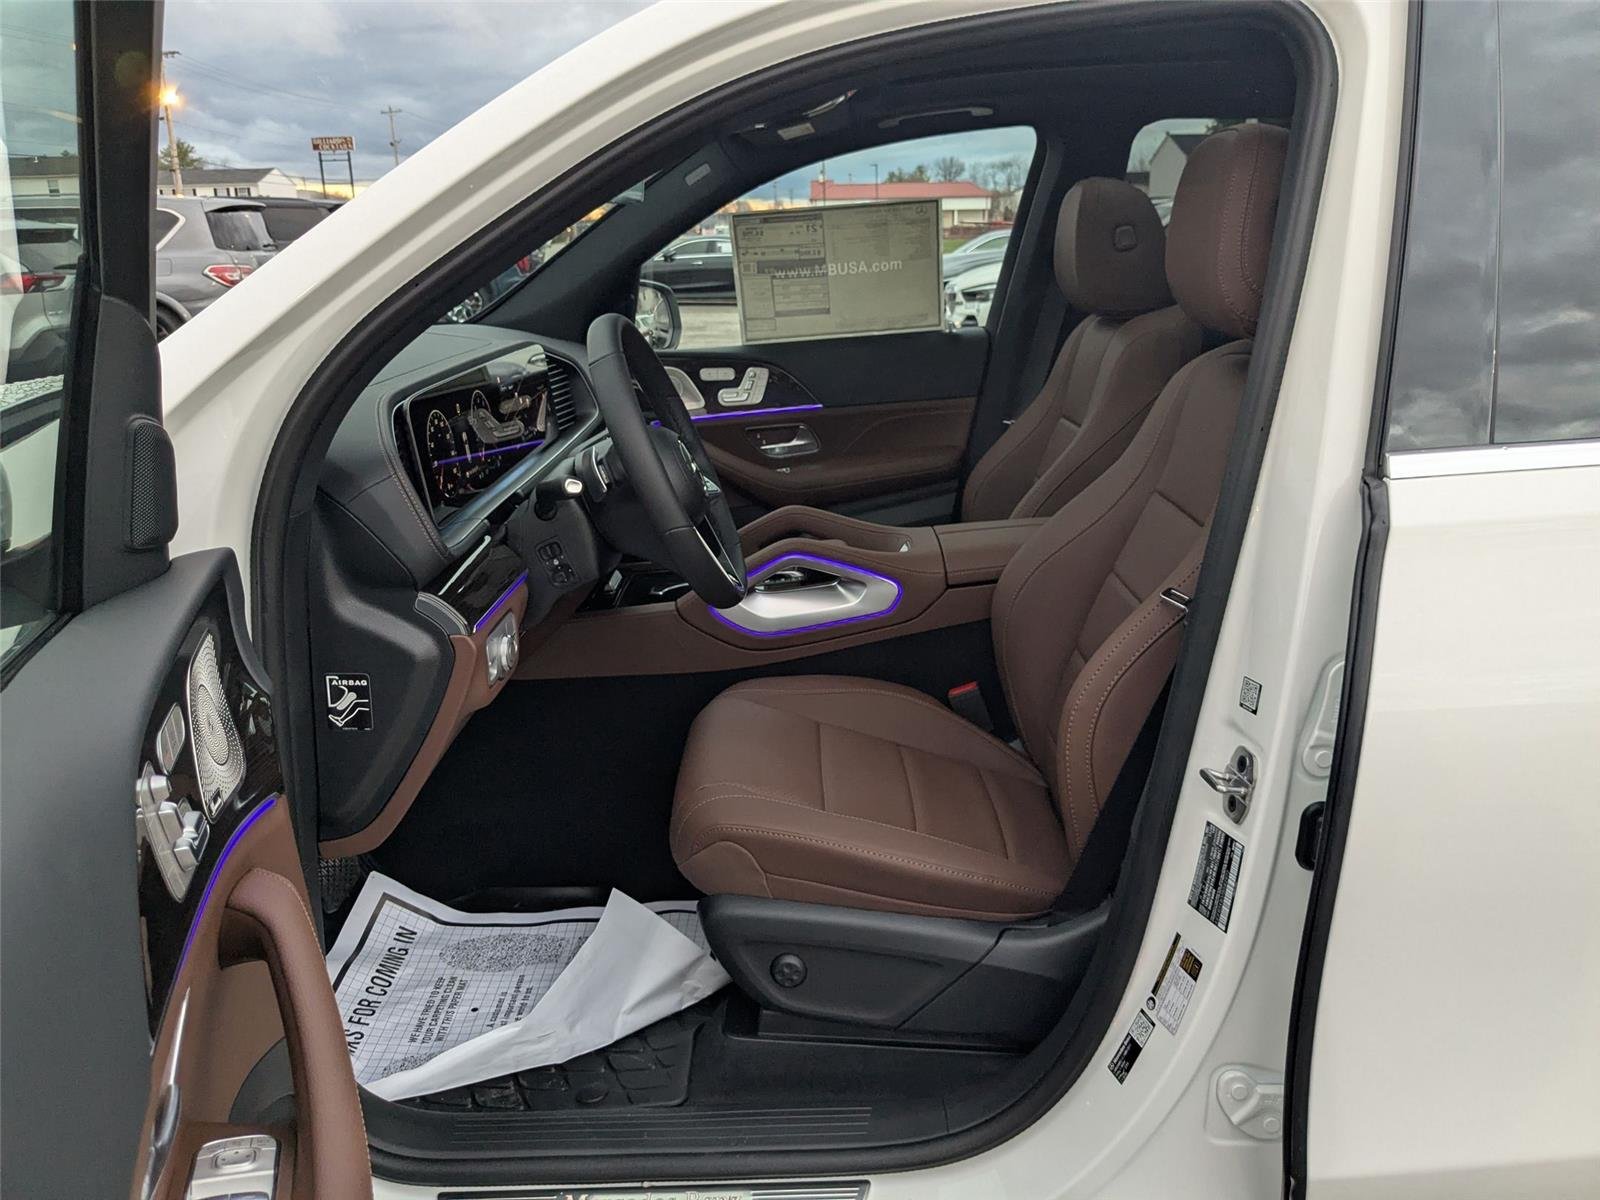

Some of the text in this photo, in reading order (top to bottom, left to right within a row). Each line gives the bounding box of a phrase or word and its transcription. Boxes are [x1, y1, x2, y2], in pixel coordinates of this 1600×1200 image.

[347, 998, 381, 1027] FOR
[365, 946, 409, 996] COMING
[393, 925, 418, 944] IN
[428, 994, 450, 1027] CARPETING
[443, 976, 458, 994] CLEAN
[429, 990, 440, 999] TO
[447, 991, 464, 1009] PAPER
[420, 999, 436, 1016] TRIED
[412, 1016, 428, 1033] HAVE
[441, 1010, 455, 1025] THIS
[408, 1032, 420, 1043] WE
[434, 1026, 450, 1042] WITH
